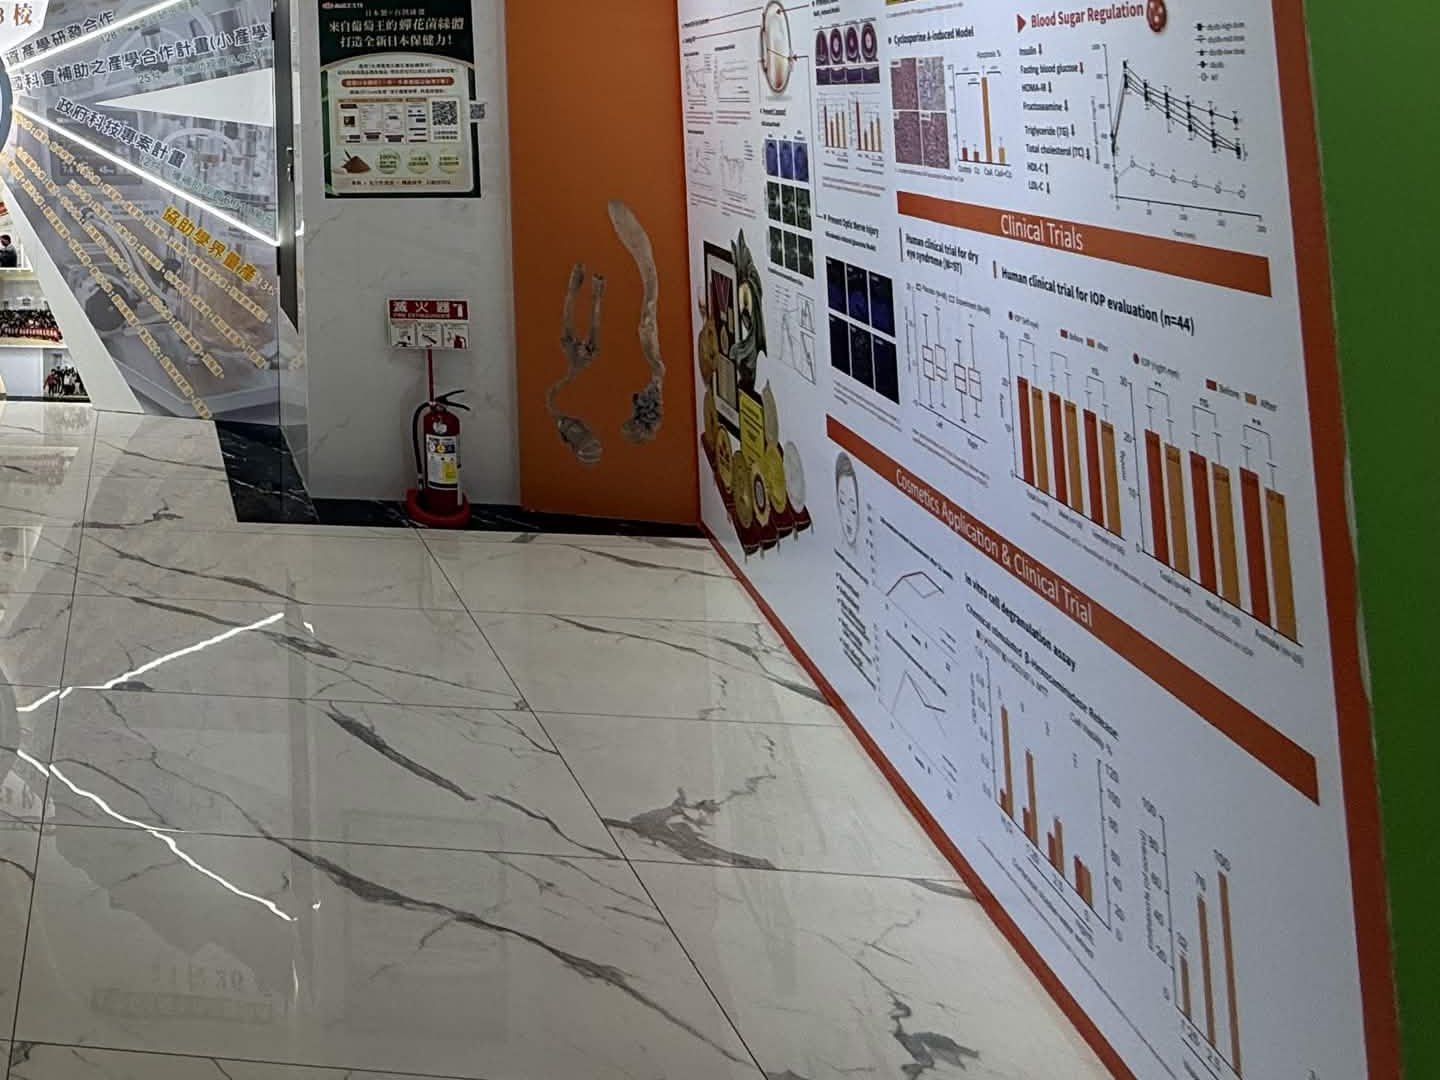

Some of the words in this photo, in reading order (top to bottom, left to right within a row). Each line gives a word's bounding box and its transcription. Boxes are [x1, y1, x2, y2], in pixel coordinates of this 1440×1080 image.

[1031, 12, 1057, 29] Blood
[1057, 8, 1086, 28] Sugar
[1087, 0, 1145, 24] Regulation
[999, 213, 1045, 244] Clinical
[1046, 222, 1084, 251] Trials
[1001, 267, 1028, 285] Human
[1028, 273, 1056, 292] clinical
[1056, 281, 1075, 298] trial
[1075, 286, 1088, 302] for
[1089, 290, 1106, 307] IOP
[1107, 299, 1159, 323] evaluation
[1160, 310, 1196, 337] (n=44)
[895, 467, 941, 514] Cosmetics
[941, 504, 1000, 559] Application
[1001, 543, 1012, 565] &
[1013, 553, 1060, 602] Clinical
[1061, 584, 1093, 628] Trial
